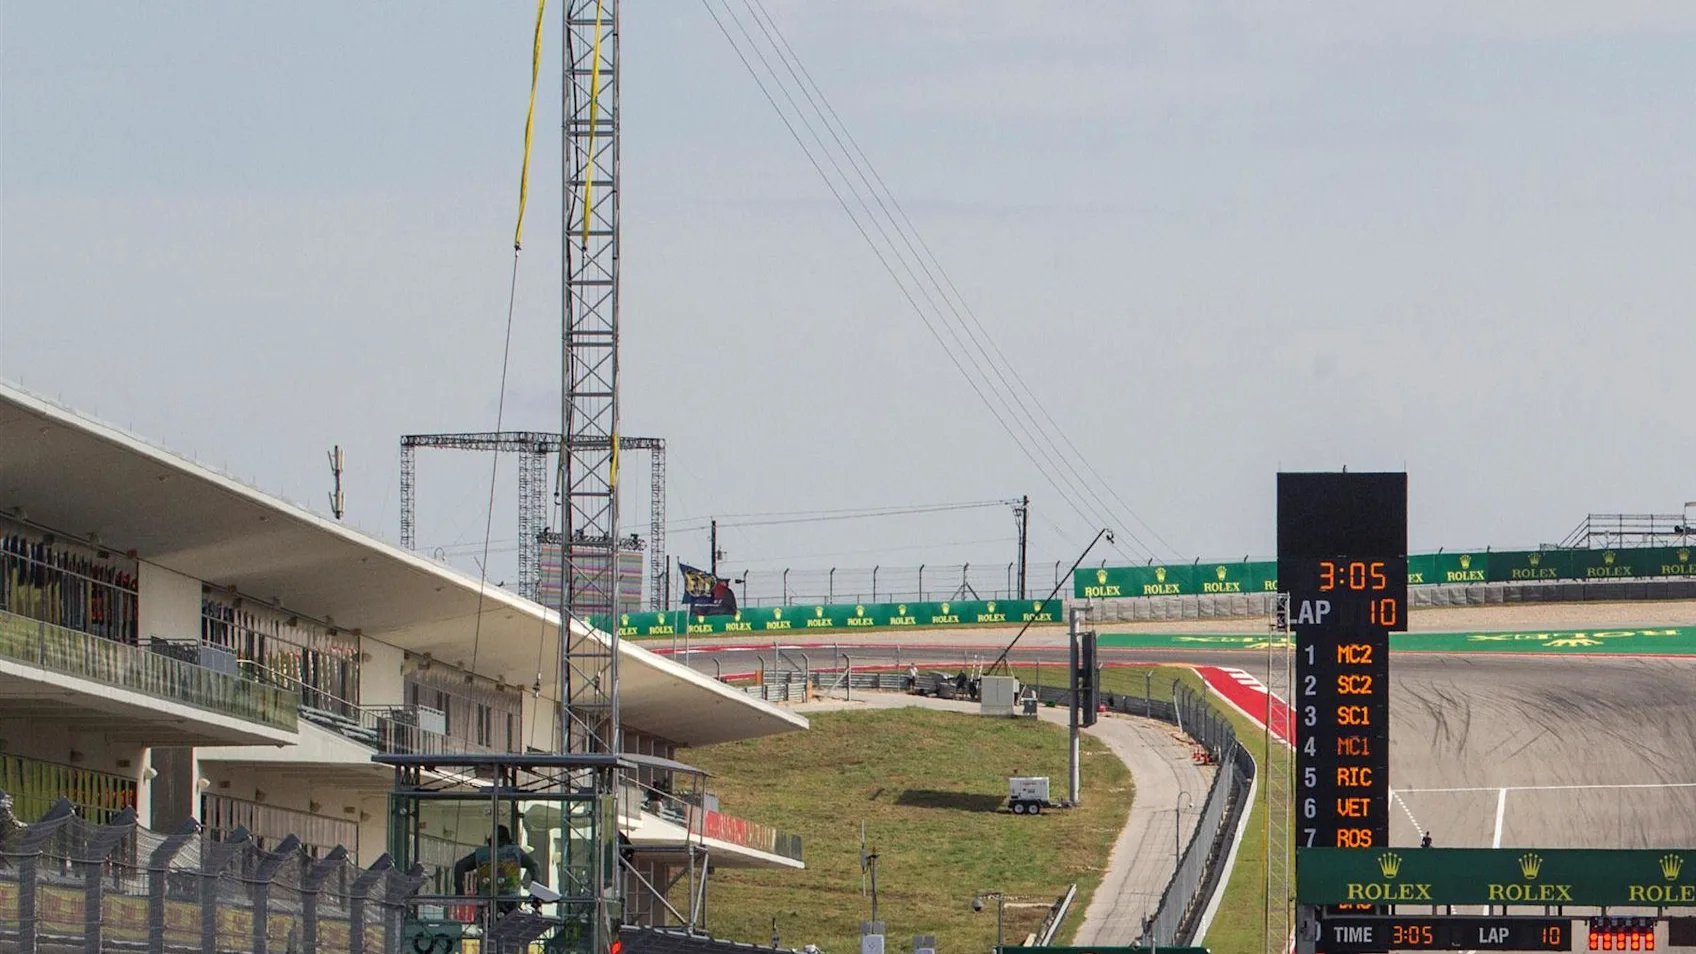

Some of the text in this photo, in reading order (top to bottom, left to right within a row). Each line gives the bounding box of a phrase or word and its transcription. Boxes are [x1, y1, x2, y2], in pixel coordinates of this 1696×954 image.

[1320, 562, 1386, 590] 3:05
[1447, 570, 1485, 581] ROLEX
[1512, 568, 1557, 578] ROLEX
[1587, 566, 1632, 577] ROLEX
[1085, 586, 1121, 597] ROLEX
[1144, 583, 1180, 594] ROLEX
[1204, 582, 1240, 593] ROLEX
[1370, 599, 1396, 626] 10
[1304, 644, 1372, 665] 1 MC2
[1304, 675, 1372, 696] 2 SC2
[1304, 705, 1370, 726] 3 SC1
[1304, 736, 1370, 757] 4 MC1
[1304, 767, 1372, 788] 5 RIC
[1304, 798, 1371, 819] 6 VET
[1304, 828, 1372, 848] 7 ROS
[1347, 884, 1432, 900] ROLEX
[1488, 884, 1573, 901] ROLEX
[1333, 926, 1373, 943] TIME
[1393, 925, 1433, 944] 3:05
[1479, 928, 1509, 944] LAP
[1542, 926, 1561, 944] 10
